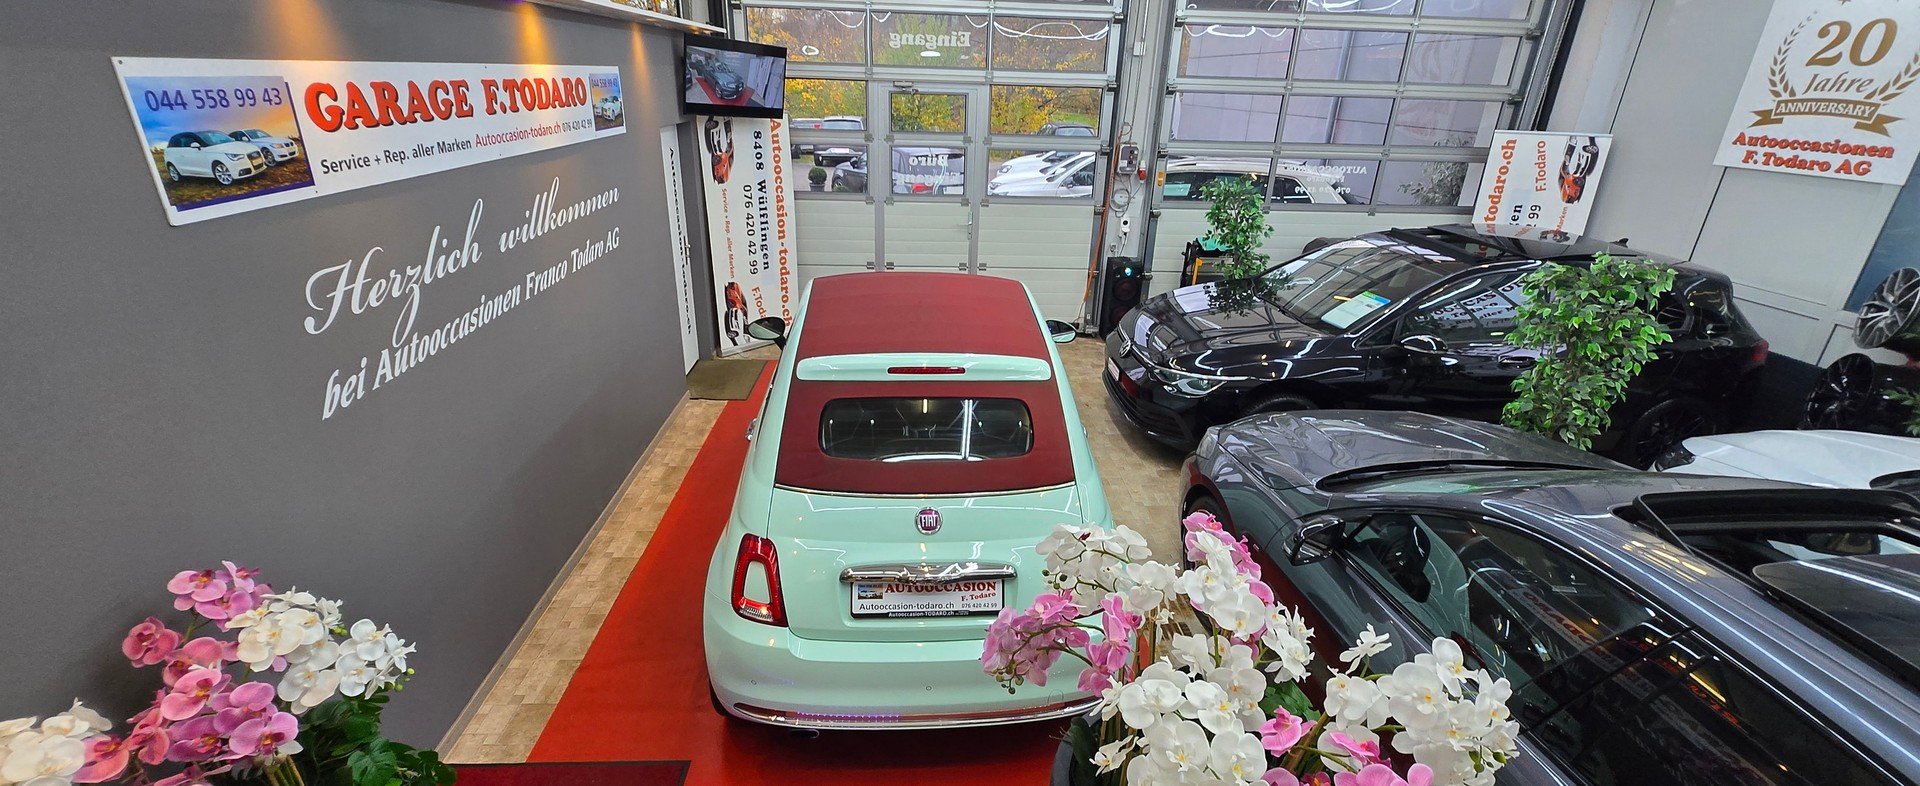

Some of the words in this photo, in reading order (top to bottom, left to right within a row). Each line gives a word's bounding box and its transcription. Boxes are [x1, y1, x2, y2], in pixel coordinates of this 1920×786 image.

[1805, 17, 1898, 68] 20
[1802, 71, 1874, 95] Jahre
[144, 89, 188, 112] 044
[192, 88, 230, 109] 558
[234, 87, 257, 107] 99
[262, 87, 282, 105] 43
[303, 79, 474, 133] GARAGE
[1776, 101, 1876, 118] ANNIVERSARY
[320, 152, 371, 175] Service
[373, 155, 381, 165] +
[384, 148, 410, 166] Rep.
[412, 143, 435, 159] aller
[437, 138, 472, 156] Marken
[475, 121, 561, 147] Autooccasion-todaro.ch
[753, 130, 765, 171] 8408
[1732, 131, 1895, 158] Autooccasionen
[1742, 150, 1758, 164] F.
[1761, 151, 1831, 172] Todaro
[1834, 159, 1872, 176] AG
[743, 184, 753, 208] 076
[745, 212, 756, 237] 420
[757, 179, 770, 271] Wülflingen
[748, 240, 758, 256] 42
[303, 198, 483, 347] Herzlich
[499, 176, 620, 253] willkommen
[727, 253, 735, 279] Marken
[750, 259, 759, 275] 99
[322, 357, 367, 420] bei
[372, 284, 521, 390] Autooccasionen
[525, 257, 568, 300] Franco
[571, 239, 603, 272] Todaro
[605, 226, 620, 254] AG
[920, 511, 938, 527] FIAT
[885, 582, 997, 594] AUTOOCCASION
[970, 592, 996, 600] Todaro
[859, 601, 954, 611] Autooccasion-todaro.ch
